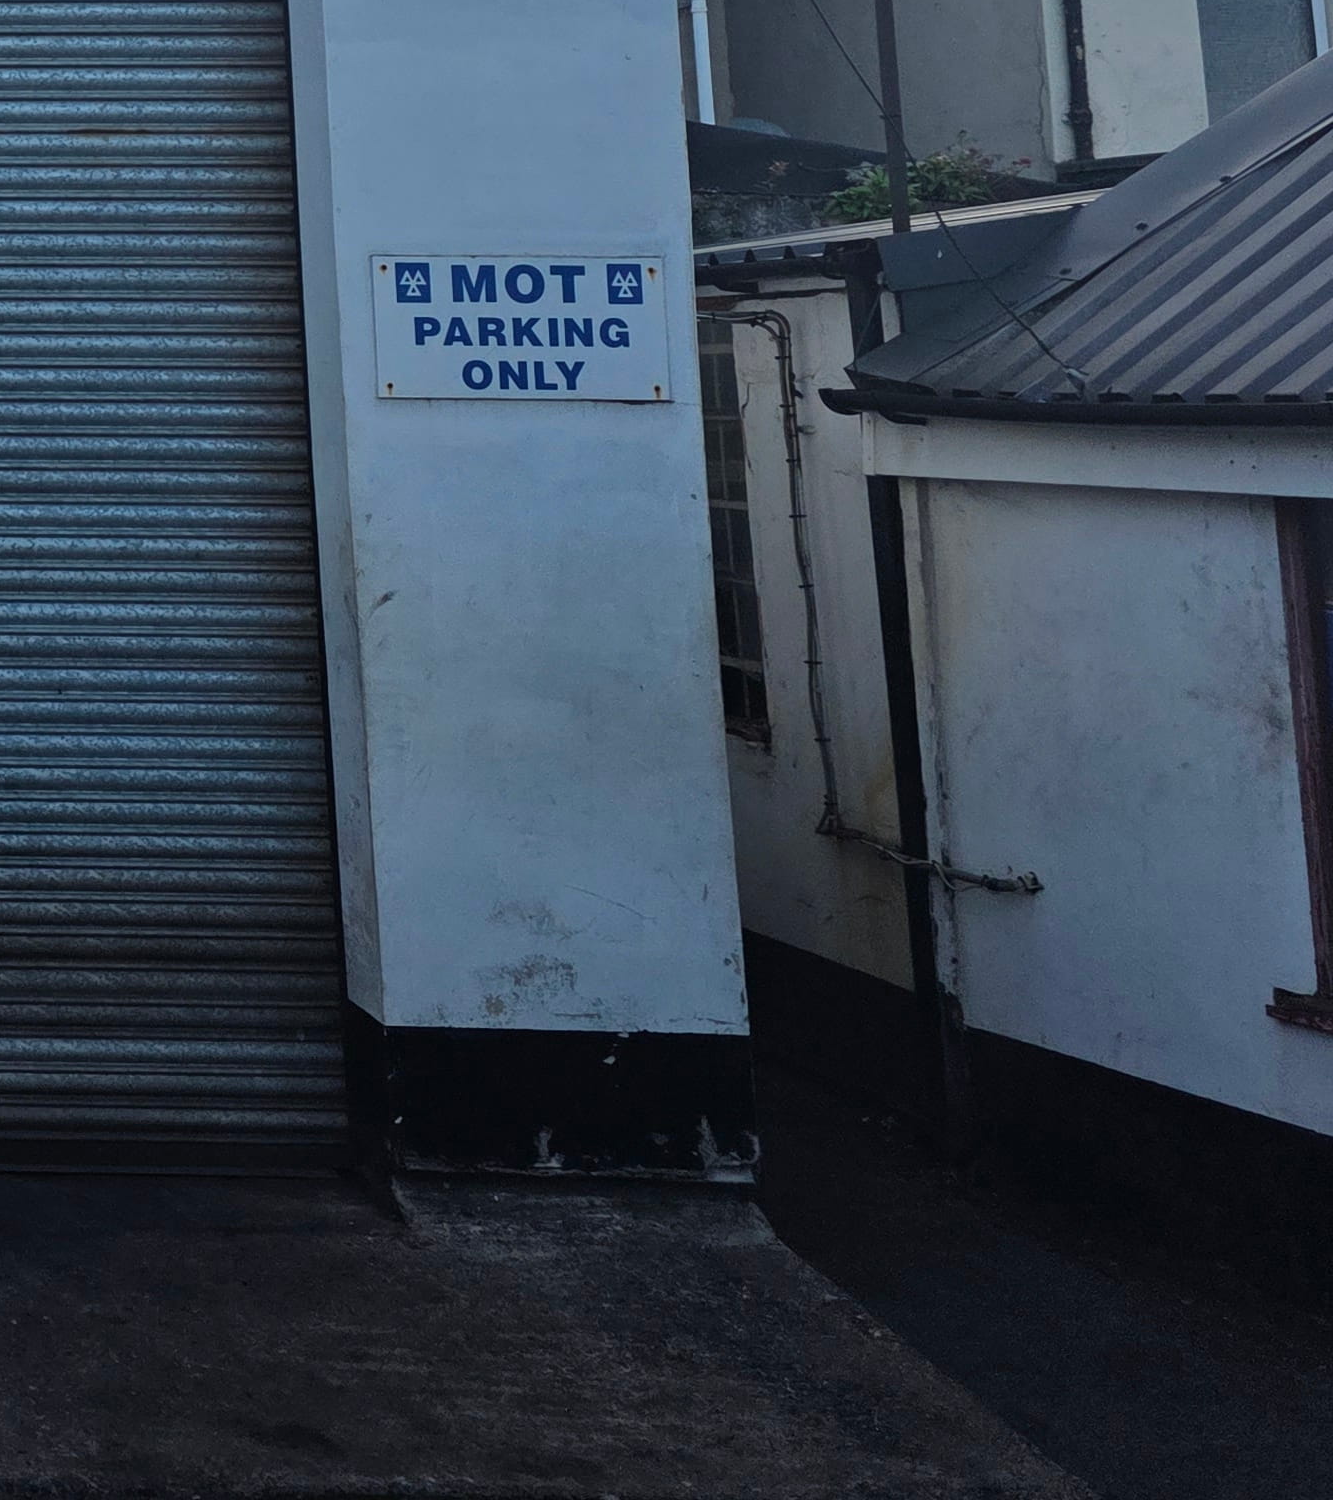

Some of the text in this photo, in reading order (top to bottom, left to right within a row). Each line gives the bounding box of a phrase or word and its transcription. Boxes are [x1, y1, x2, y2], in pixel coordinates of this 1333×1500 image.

[450, 264, 586, 304] MOT
[413, 316, 631, 348] PARKING
[461, 360, 586, 391] ONLY
